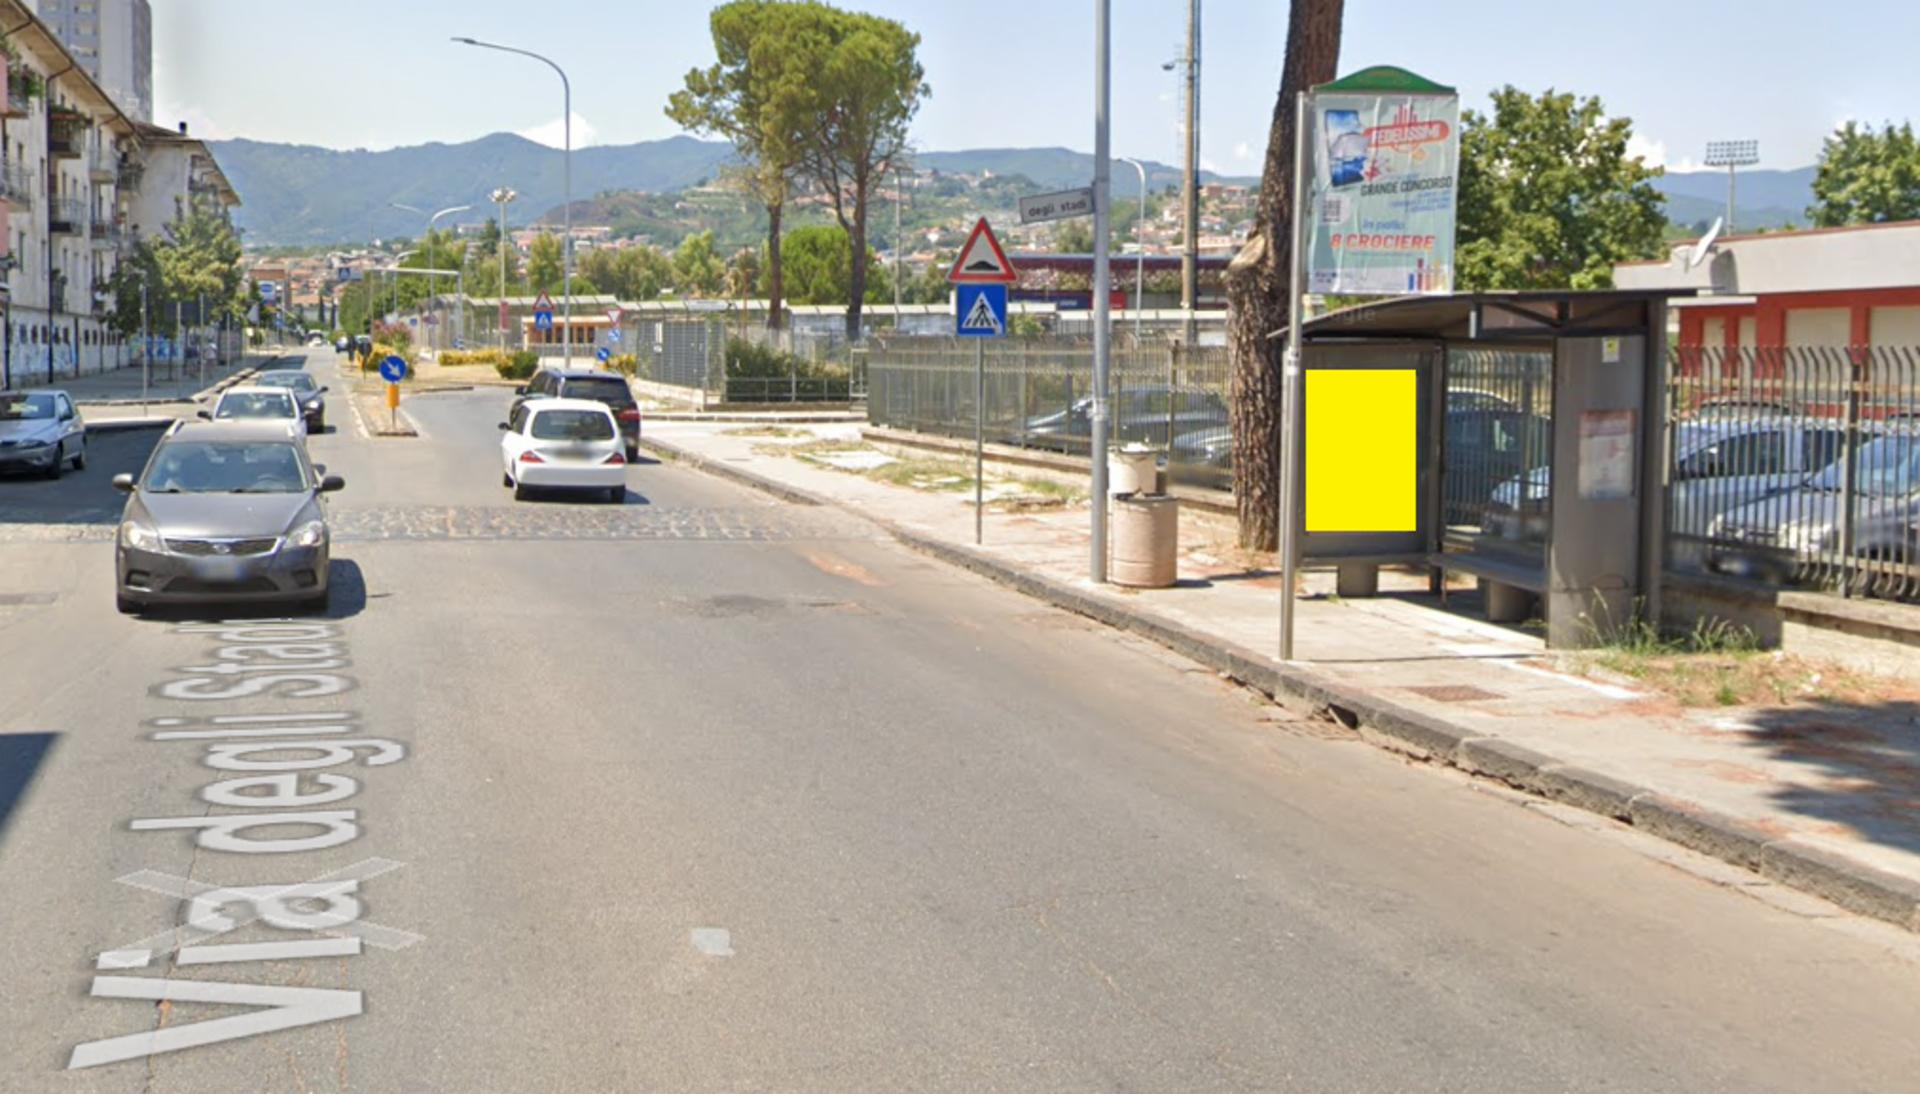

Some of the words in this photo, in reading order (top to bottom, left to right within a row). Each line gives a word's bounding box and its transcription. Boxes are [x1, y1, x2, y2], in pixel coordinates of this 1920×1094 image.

[1371, 124, 1441, 144] FEDELISSIMI
[1360, 181, 1398, 196] GRANDE
[1400, 176, 1453, 193] CONCORSO
[1028, 203, 1055, 216] degli
[1330, 233, 1342, 249] 8
[1346, 233, 1436, 250] CROCIERE
